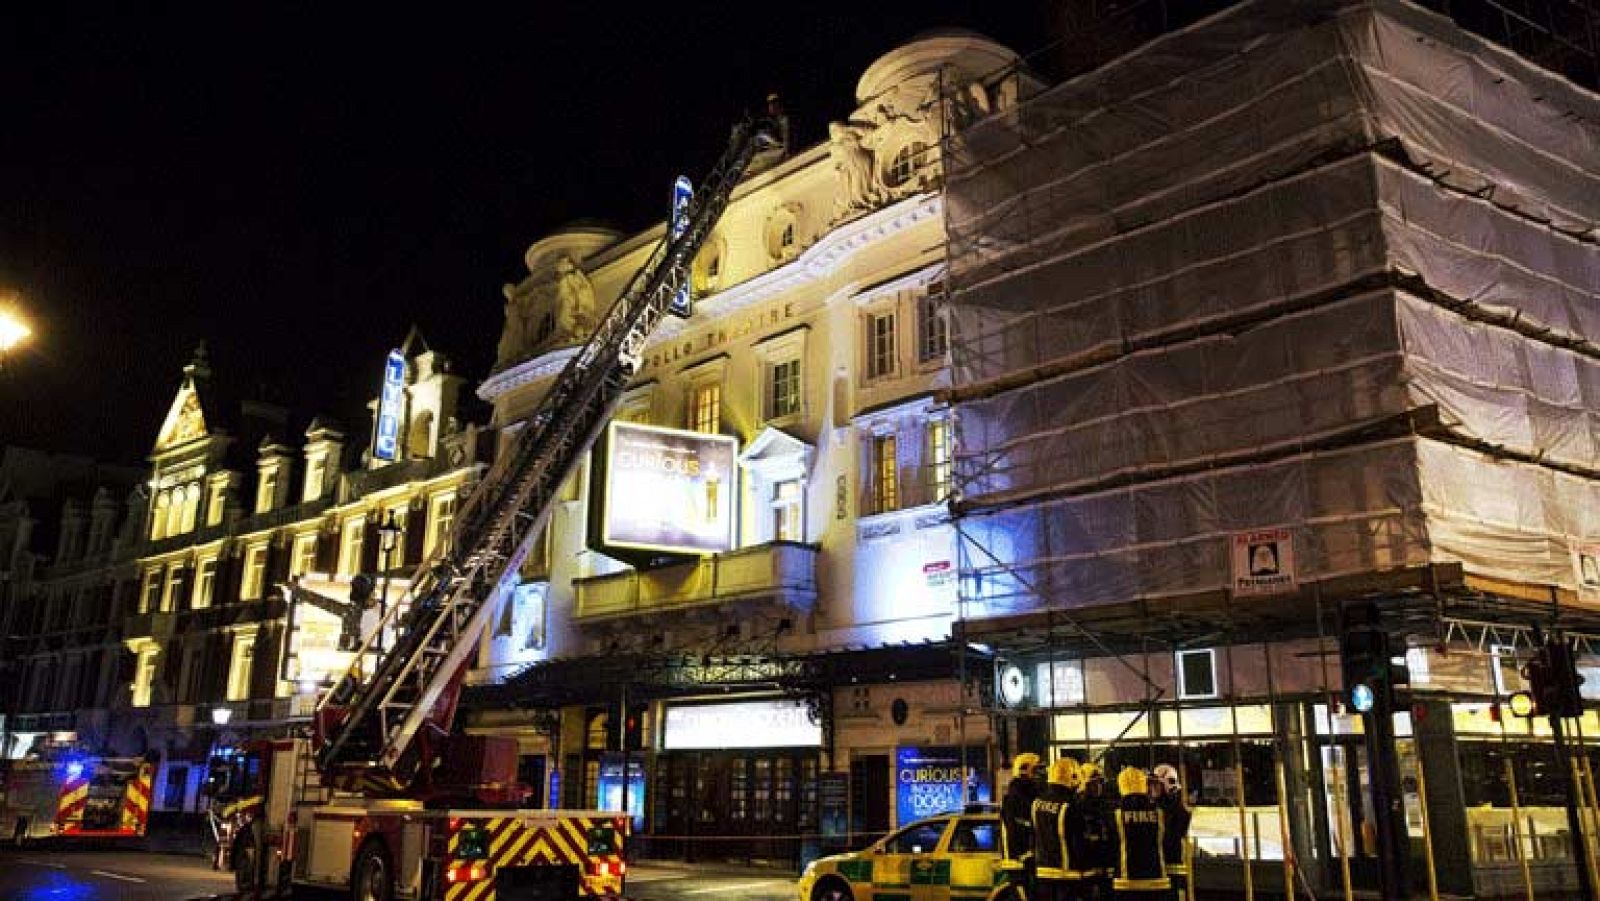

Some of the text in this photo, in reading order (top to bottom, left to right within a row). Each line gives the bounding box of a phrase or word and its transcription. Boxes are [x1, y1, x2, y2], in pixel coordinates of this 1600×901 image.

[707, 302, 793, 344] THEATRE
[618, 450, 700, 475] CURIOUS
[899, 767, 961, 783] CURIOUS
[914, 794, 949, 808] DOG
[1034, 799, 1059, 814] FIRE
[1124, 810, 1158, 823] FIRE
